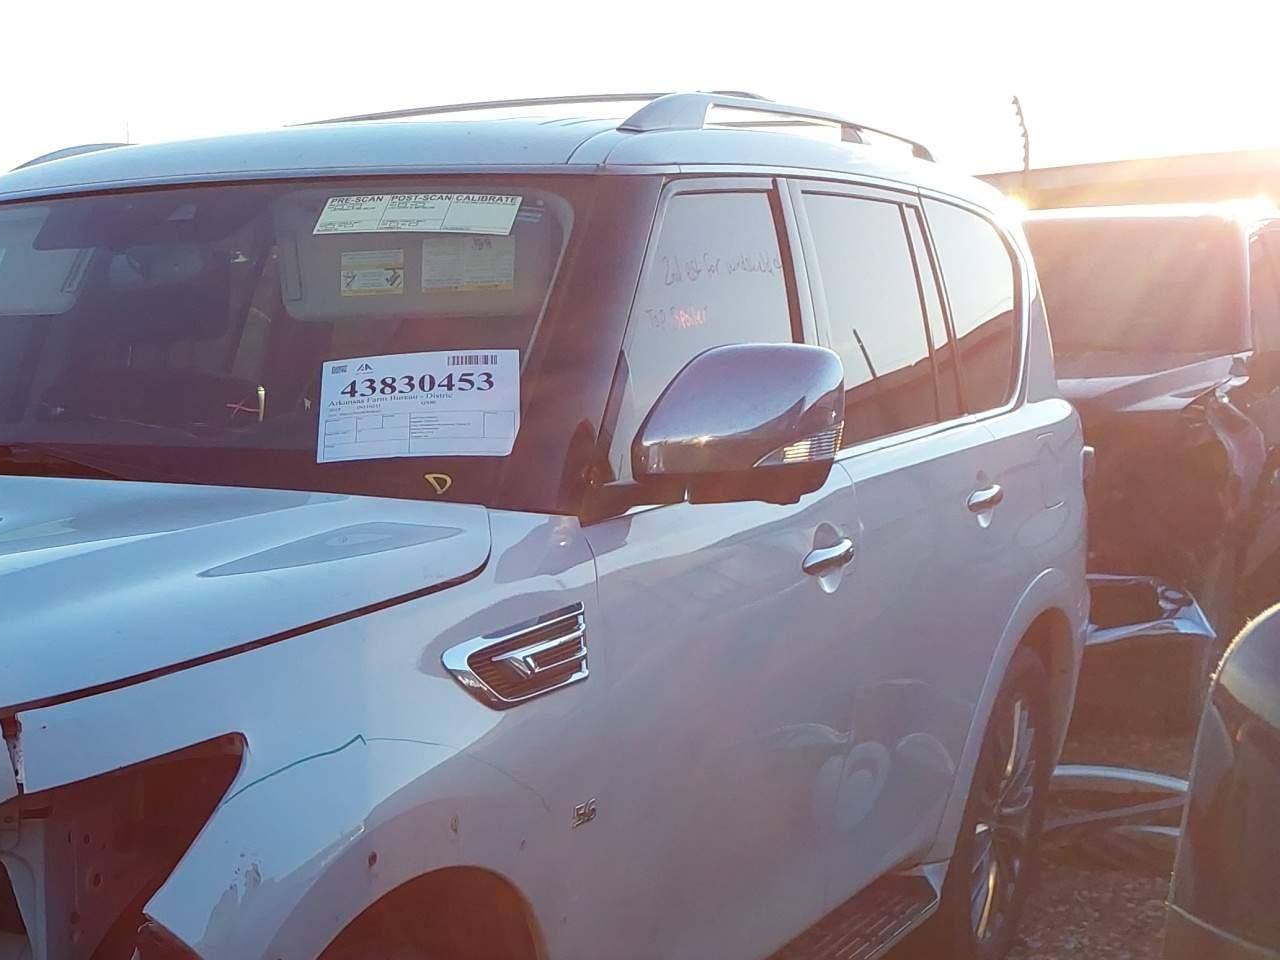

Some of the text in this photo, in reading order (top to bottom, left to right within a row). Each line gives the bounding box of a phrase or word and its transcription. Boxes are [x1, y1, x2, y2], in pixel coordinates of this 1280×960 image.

[331, 195, 384, 204] PRE-SCAN
[455, 194, 516, 203] CALIBRATE
[340, 372, 494, 398] 43830453
